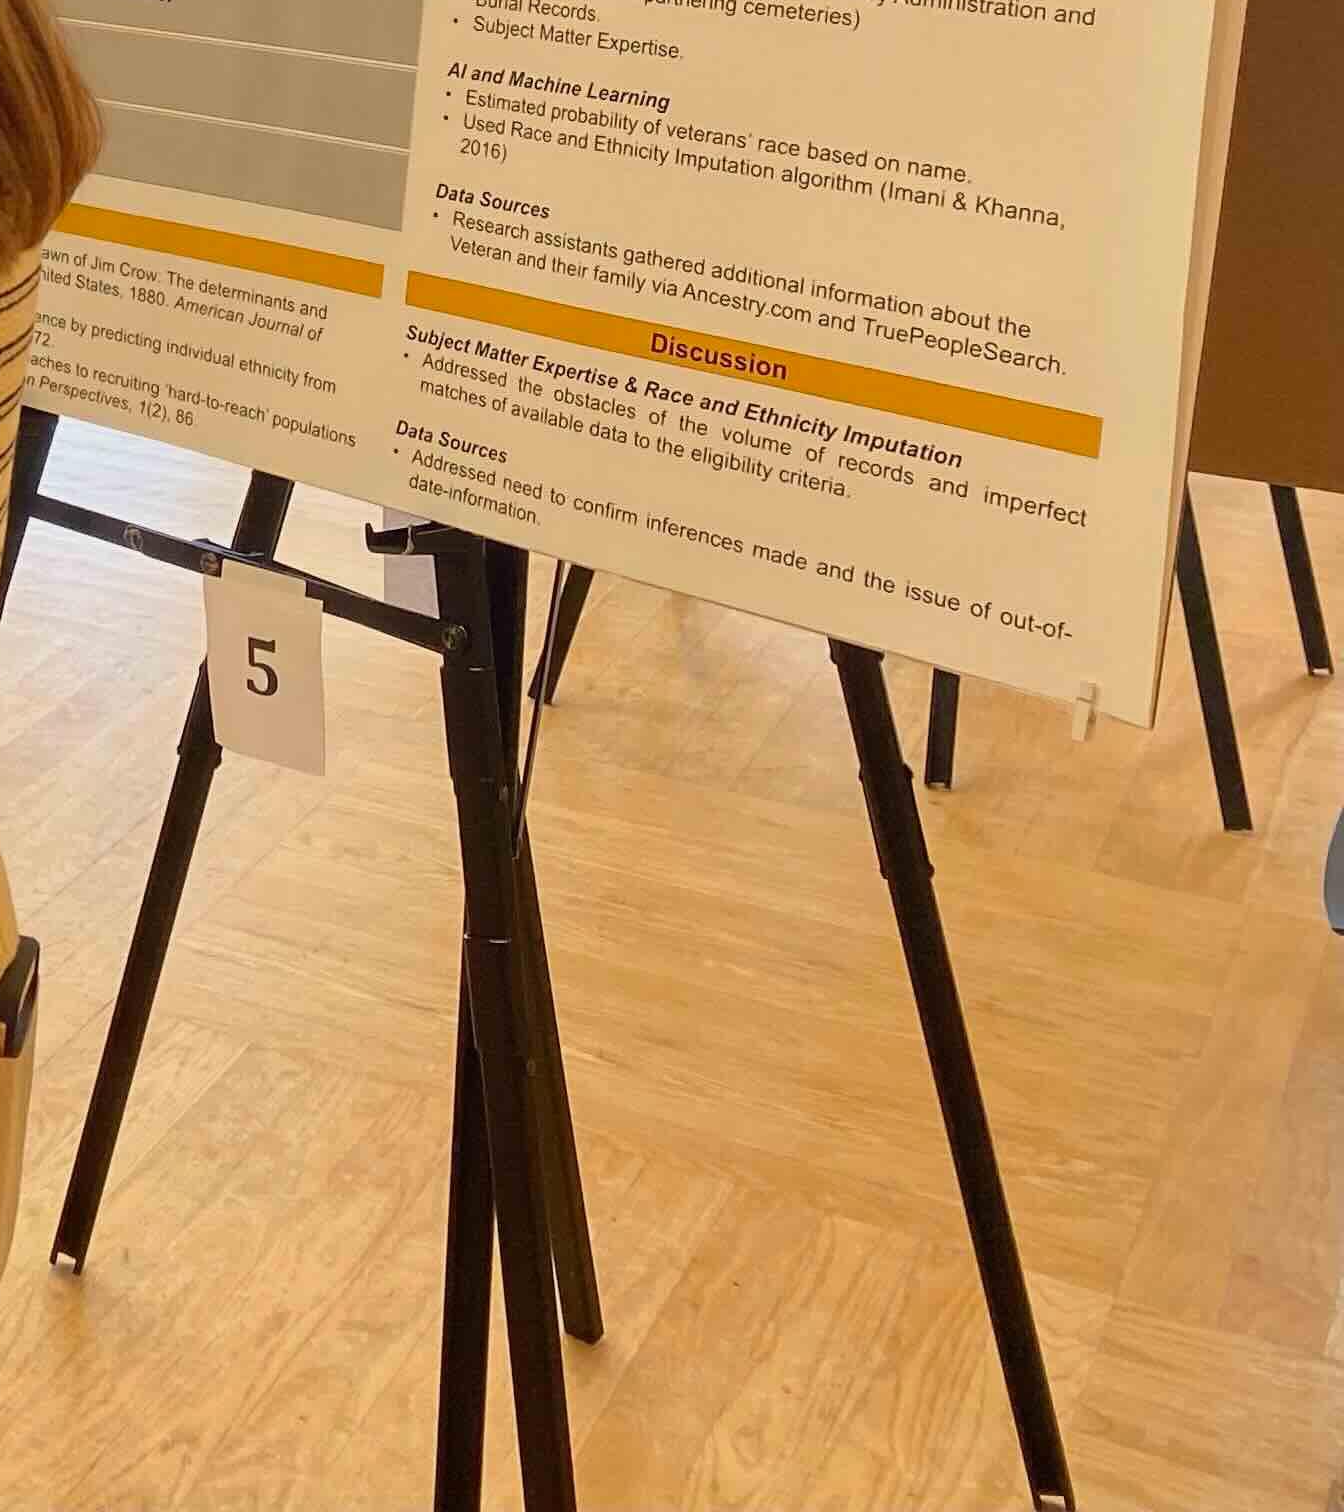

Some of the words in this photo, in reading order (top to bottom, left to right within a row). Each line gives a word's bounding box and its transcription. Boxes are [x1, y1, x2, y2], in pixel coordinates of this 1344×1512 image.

[1054, 8, 1095, 25] and
[448, 63, 467, 78] AI
[471, 69, 505, 84] and
[509, 71, 581, 96] Machine
[586, 82, 670, 113] Learning
[74, 254, 88, 267] of
[91, 256, 114, 273] Jim
[120, 262, 160, 281] Crow.
[168, 271, 194, 290] The
[199, 280, 295, 312] determinants
[300, 304, 327, 319] and
[651, 333, 787, 380] Discussion
[407, 325, 471, 353] Subject
[475, 341, 529, 367] Matter
[533, 355, 618, 389] Expertise
[625, 377, 637, 393] &
[644, 381, 693, 405] Race
[700, 397, 740, 415] and
[744, 403, 838, 441] Ethnicity
[843, 425, 961, 468] Imputation
[246, 636, 279, 696] 5
